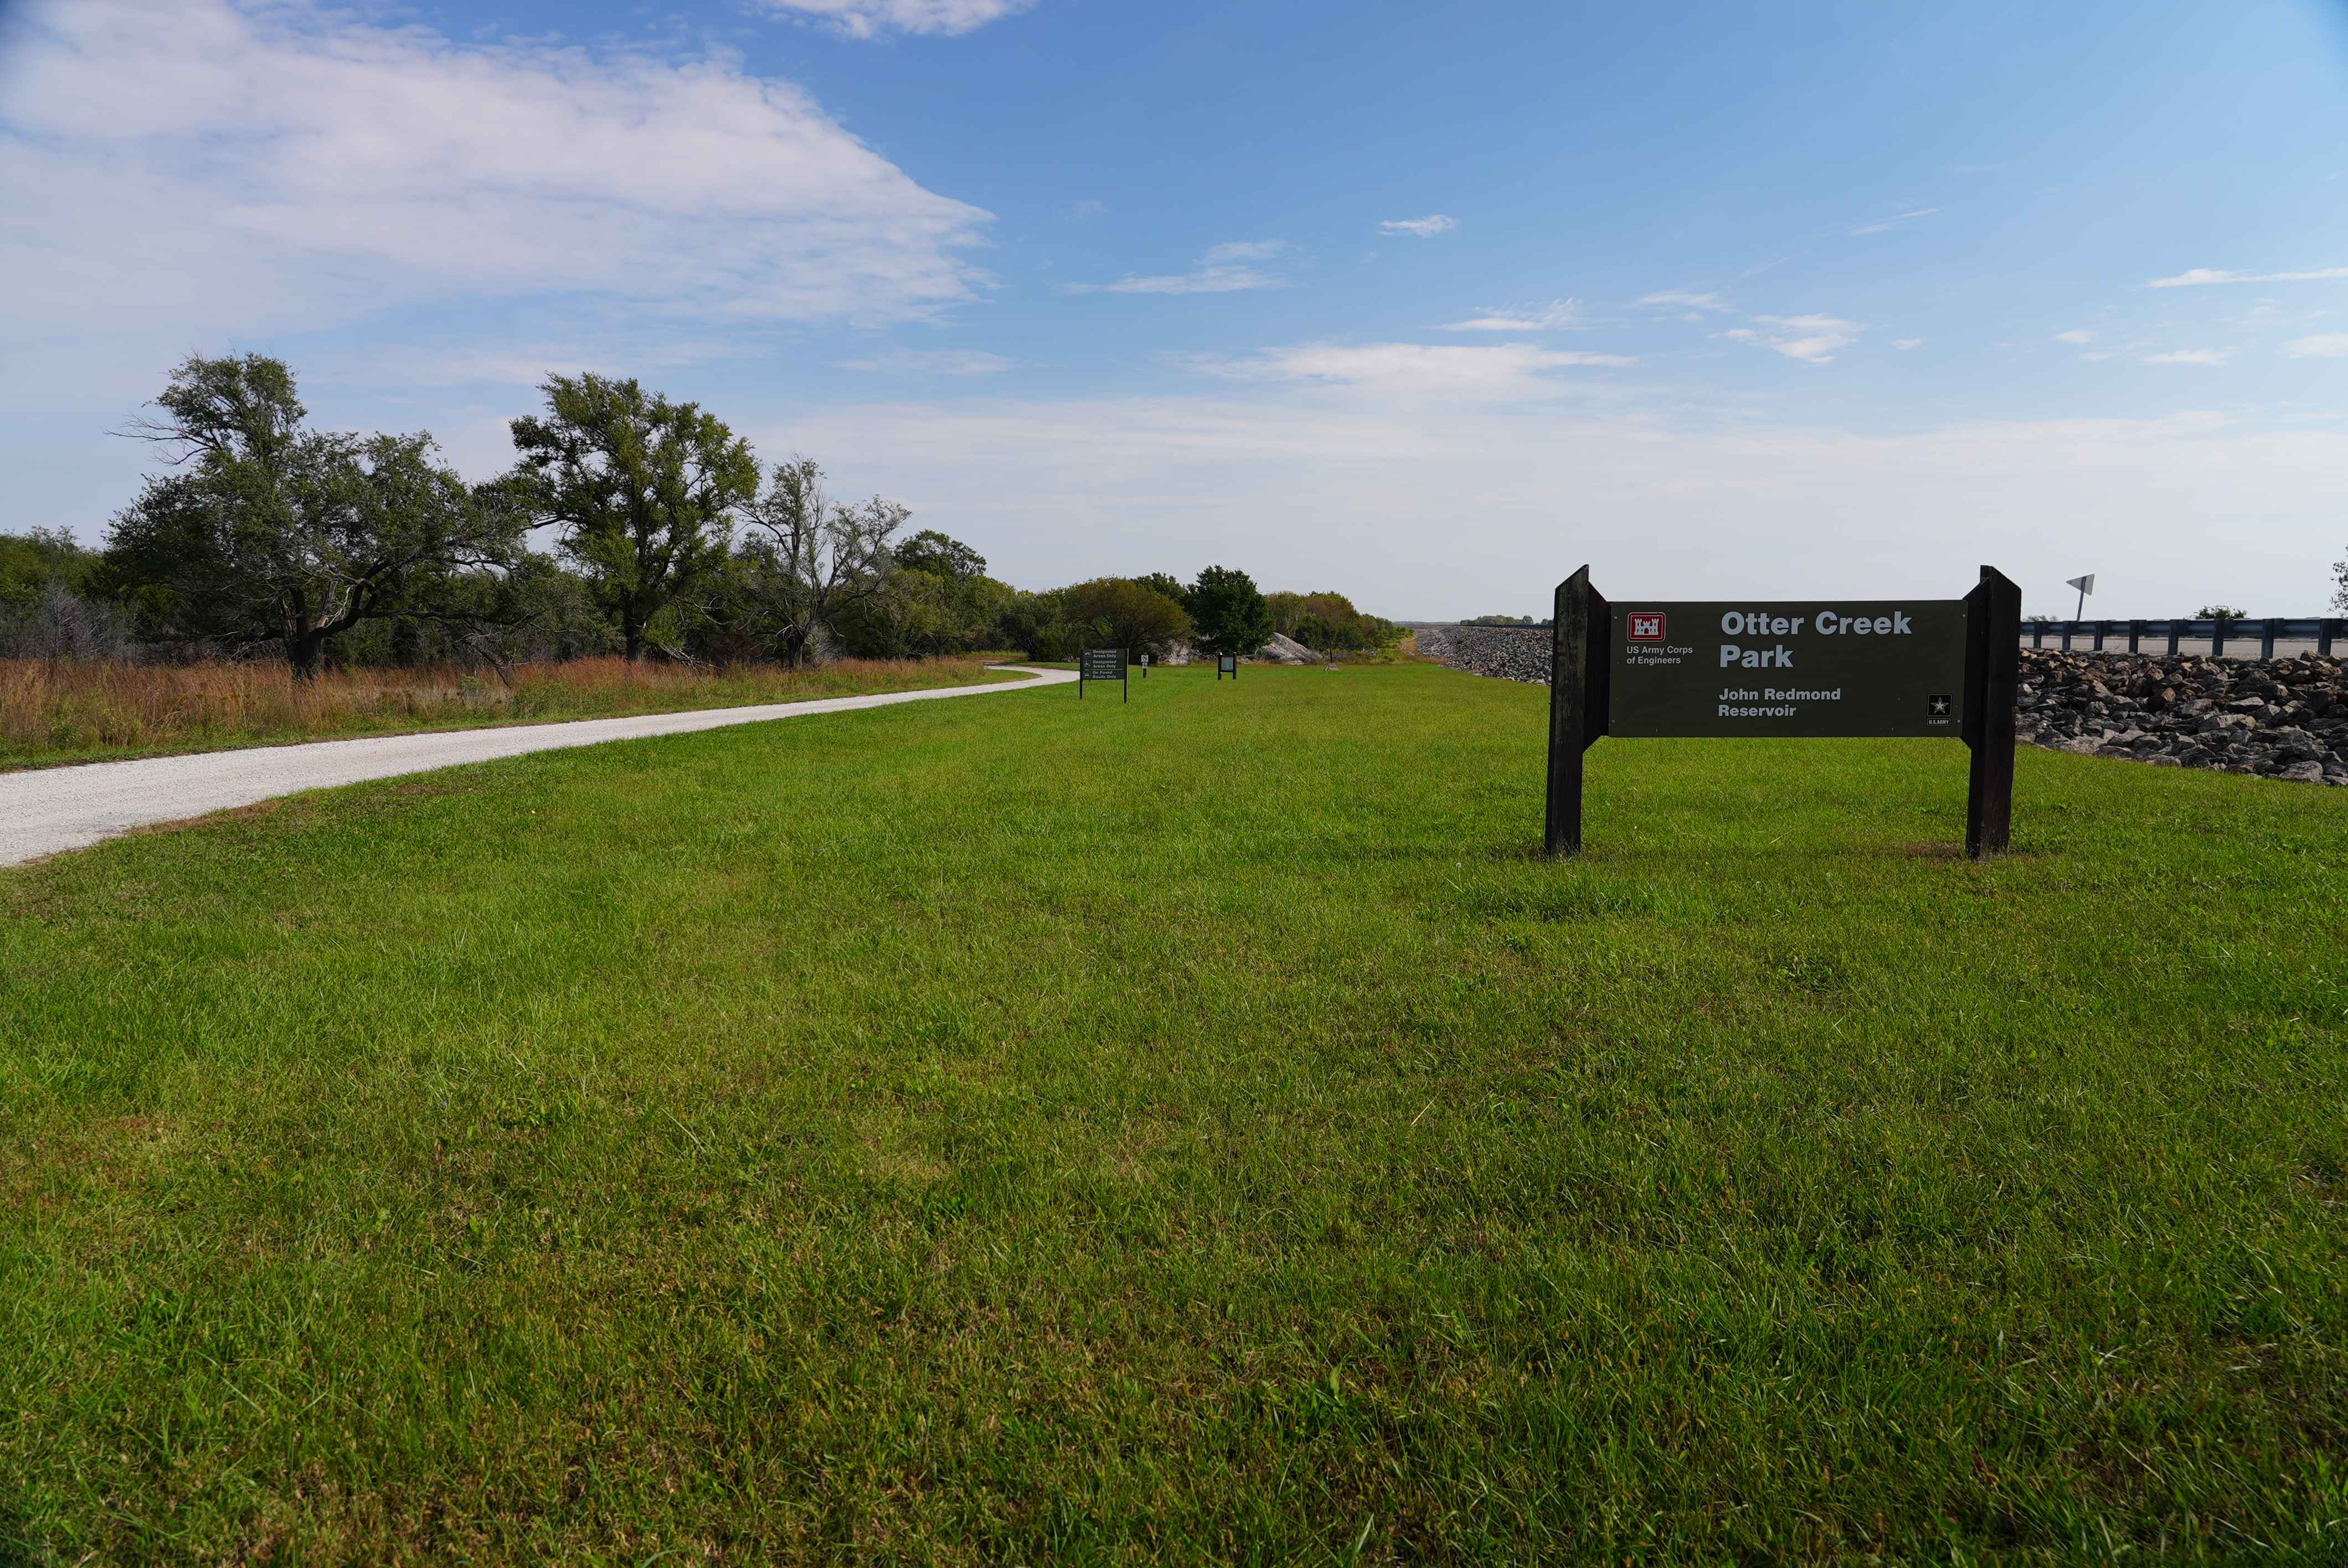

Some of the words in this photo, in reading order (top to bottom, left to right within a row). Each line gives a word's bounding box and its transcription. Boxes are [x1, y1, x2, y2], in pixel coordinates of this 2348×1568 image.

[1721, 611, 1804, 635] Otter
[1816, 611, 1912, 635] Creek
[1626, 646, 1639, 654] US
[1641, 646, 1665, 656] Army
[1667, 646, 1693, 655] Corps
[1720, 644, 1794, 668] Park
[1626, 656, 1635, 664] of
[1638, 656, 1681, 666] Engineers
[1719, 688, 1758, 700] John
[1764, 688, 1841, 700] Redmond
[1718, 704, 1796, 716] Reservoir
